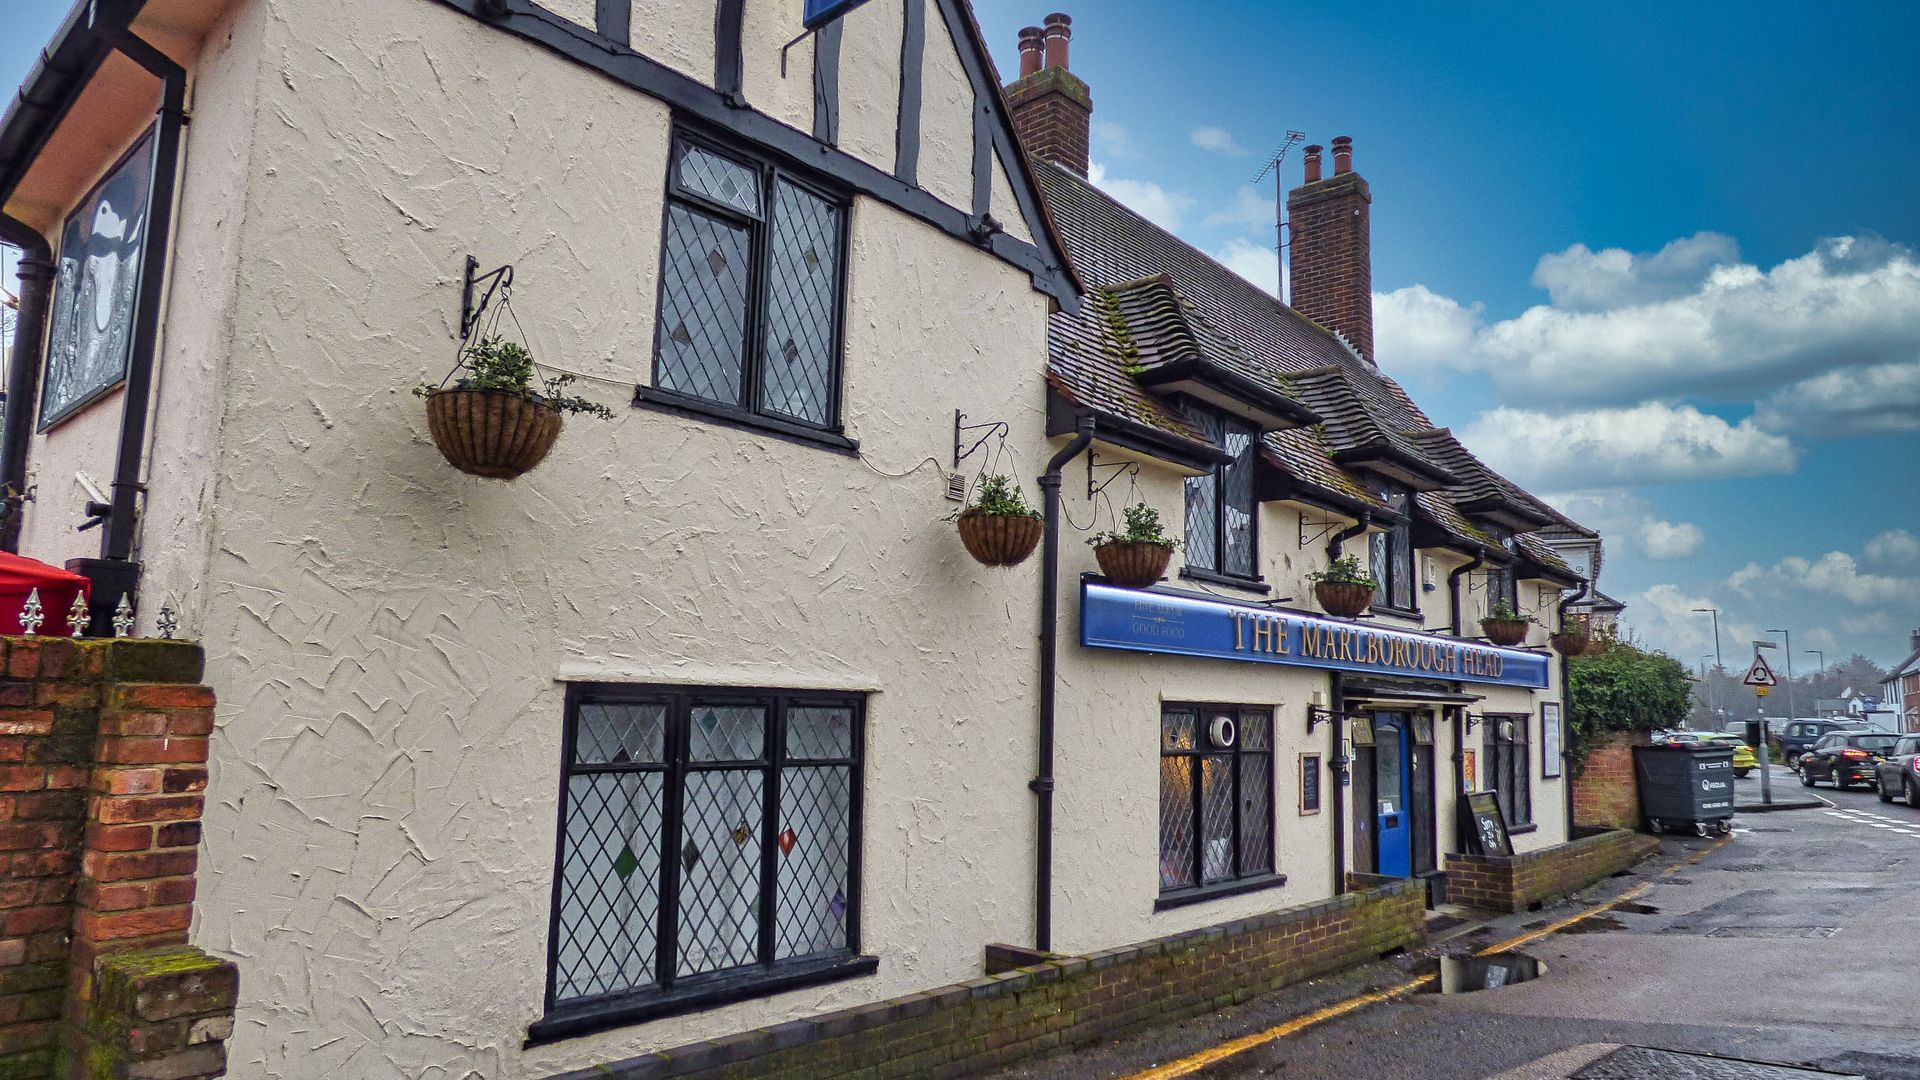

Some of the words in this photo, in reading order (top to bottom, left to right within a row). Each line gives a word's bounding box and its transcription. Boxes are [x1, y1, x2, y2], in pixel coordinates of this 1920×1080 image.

[1134, 599, 1154, 613] FINE
[1132, 622, 1158, 636] GOOD
[1161, 627, 1185, 640] FOOD
[1229, 608, 1290, 654] THE
[1301, 621, 1457, 673] MARLBOROUGH
[1463, 646, 1504, 678] HEAD
